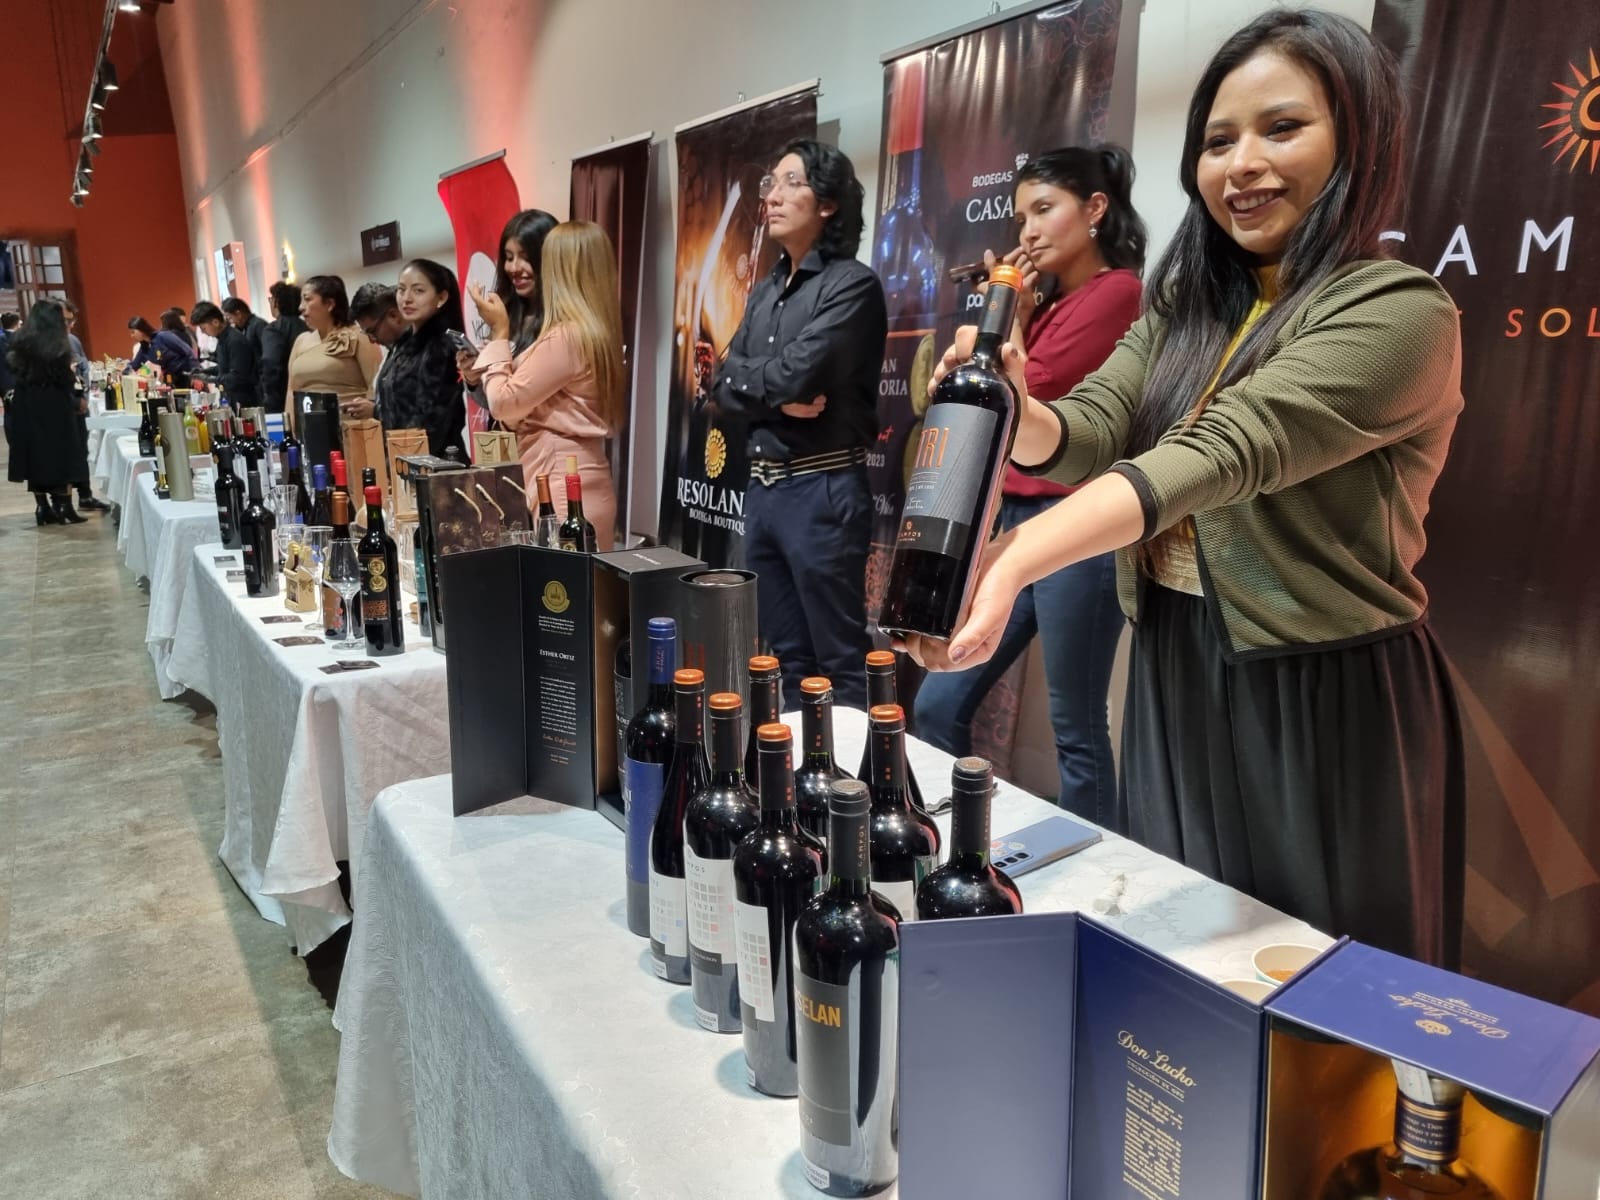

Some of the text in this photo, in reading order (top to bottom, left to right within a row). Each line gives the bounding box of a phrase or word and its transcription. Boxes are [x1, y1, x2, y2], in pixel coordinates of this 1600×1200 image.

[972, 171, 1013, 187] BODEGAS
[966, 195, 1015, 222] CASA
[1378, 216, 1574, 277] AM
[881, 359, 897, 373] AN
[879, 379, 908, 396] ORIA
[866, 453, 885, 467] 2023
[677, 477, 746, 518] RESOLAN
[689, 508, 712, 525] BODEGA
[1117, 1030, 1197, 1087] Don Lucho
